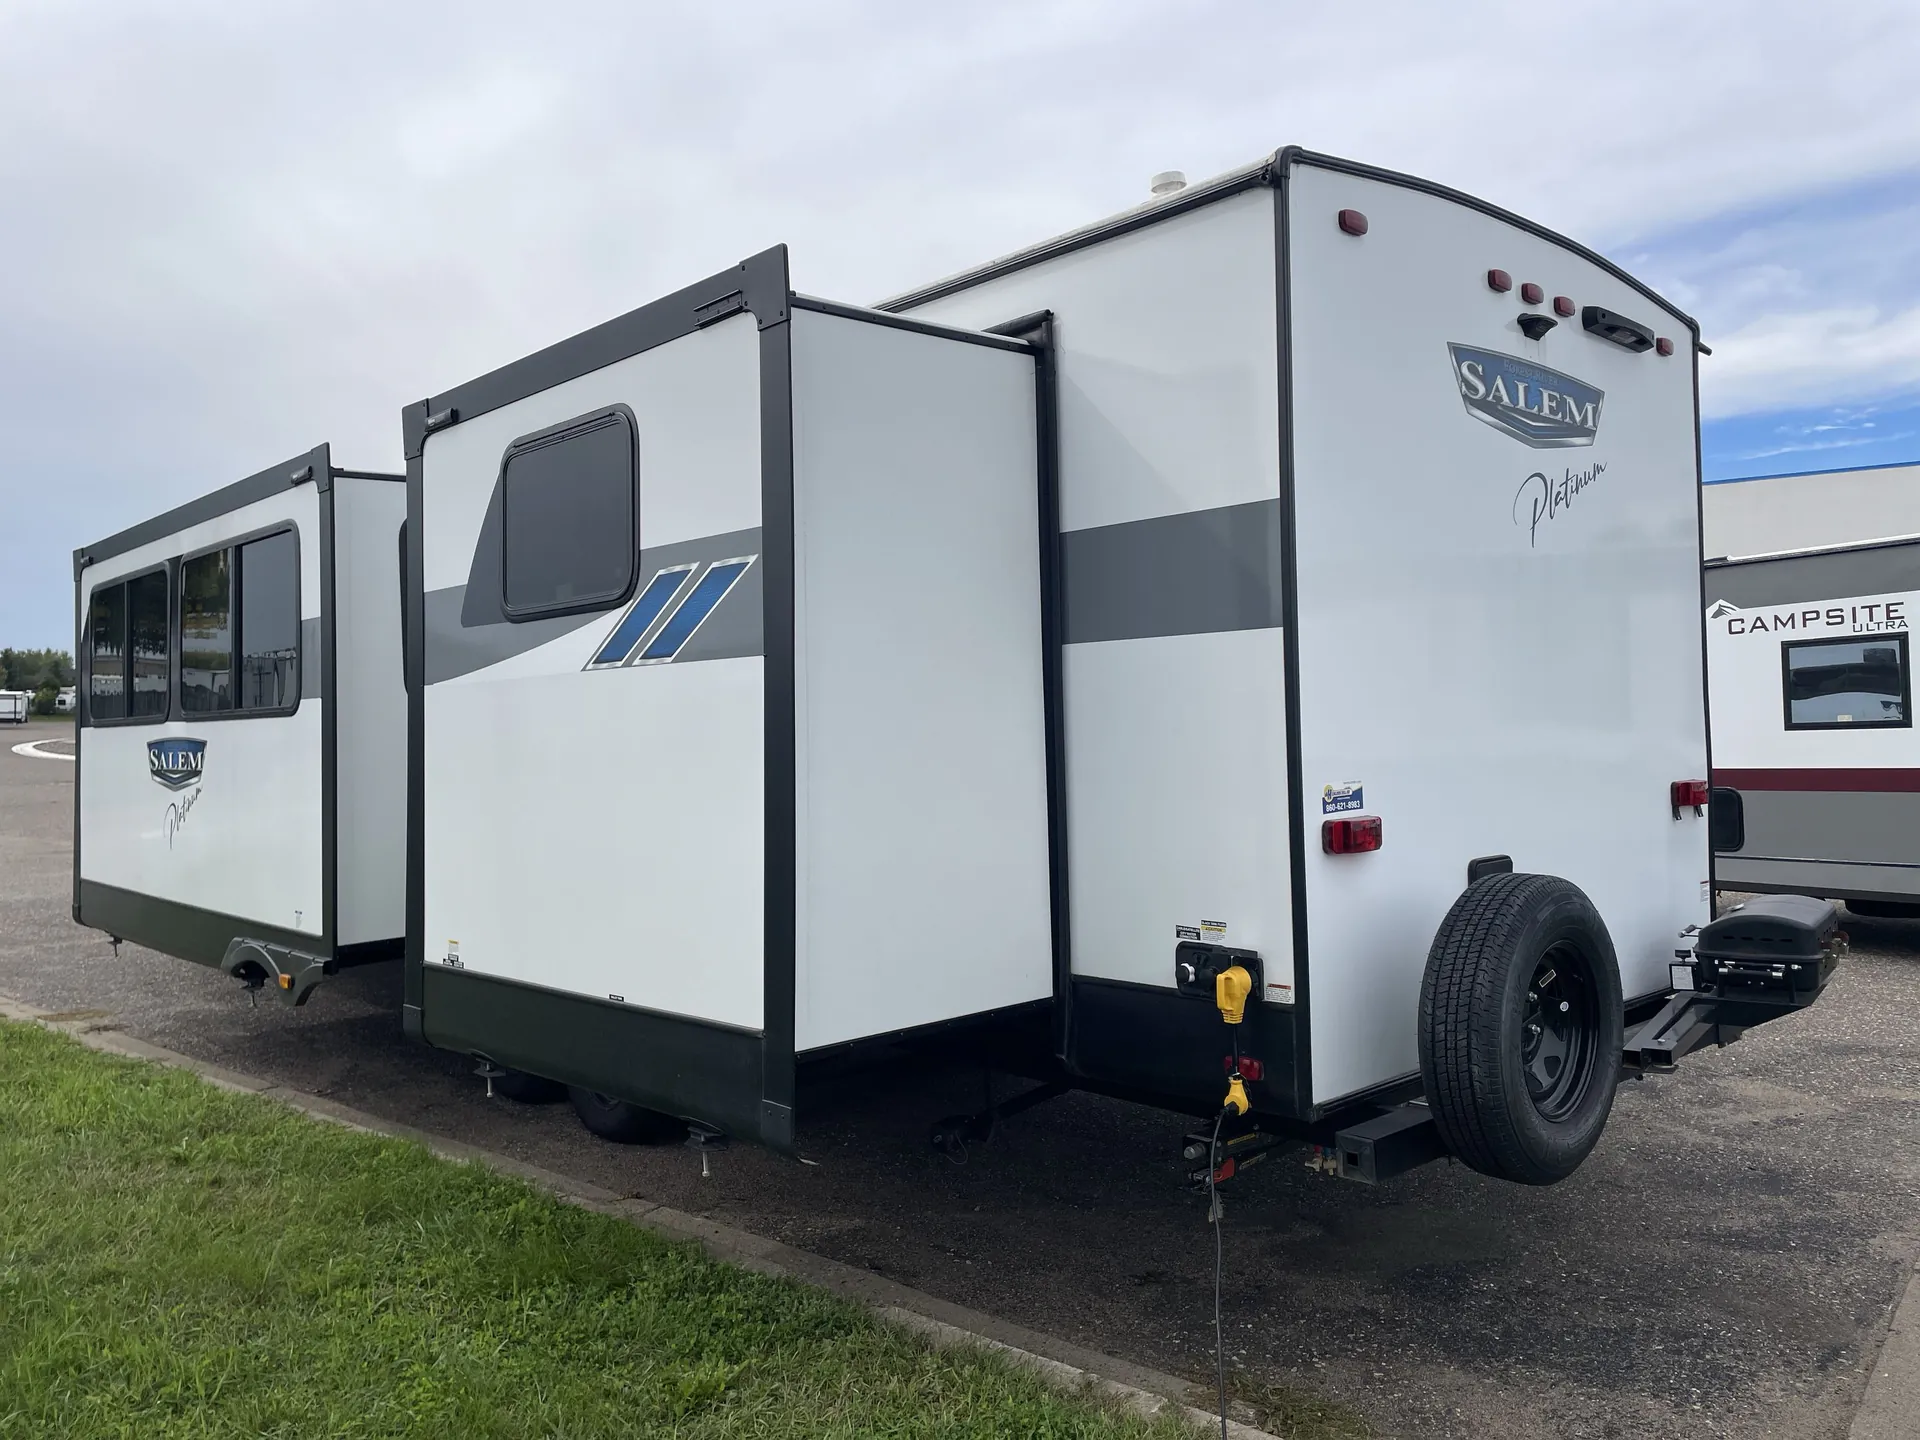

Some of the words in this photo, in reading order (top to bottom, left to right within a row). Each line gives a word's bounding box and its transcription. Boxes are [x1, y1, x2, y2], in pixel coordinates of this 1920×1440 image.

[1460, 359, 1597, 430] SALEM
[1513, 461, 1608, 548] Platinum
[1727, 601, 1905, 635] CAMPSITE
[1852, 619, 1909, 633] ULTRA
[150, 748, 203, 771] SALEM
[163, 784, 204, 850] Platinum
